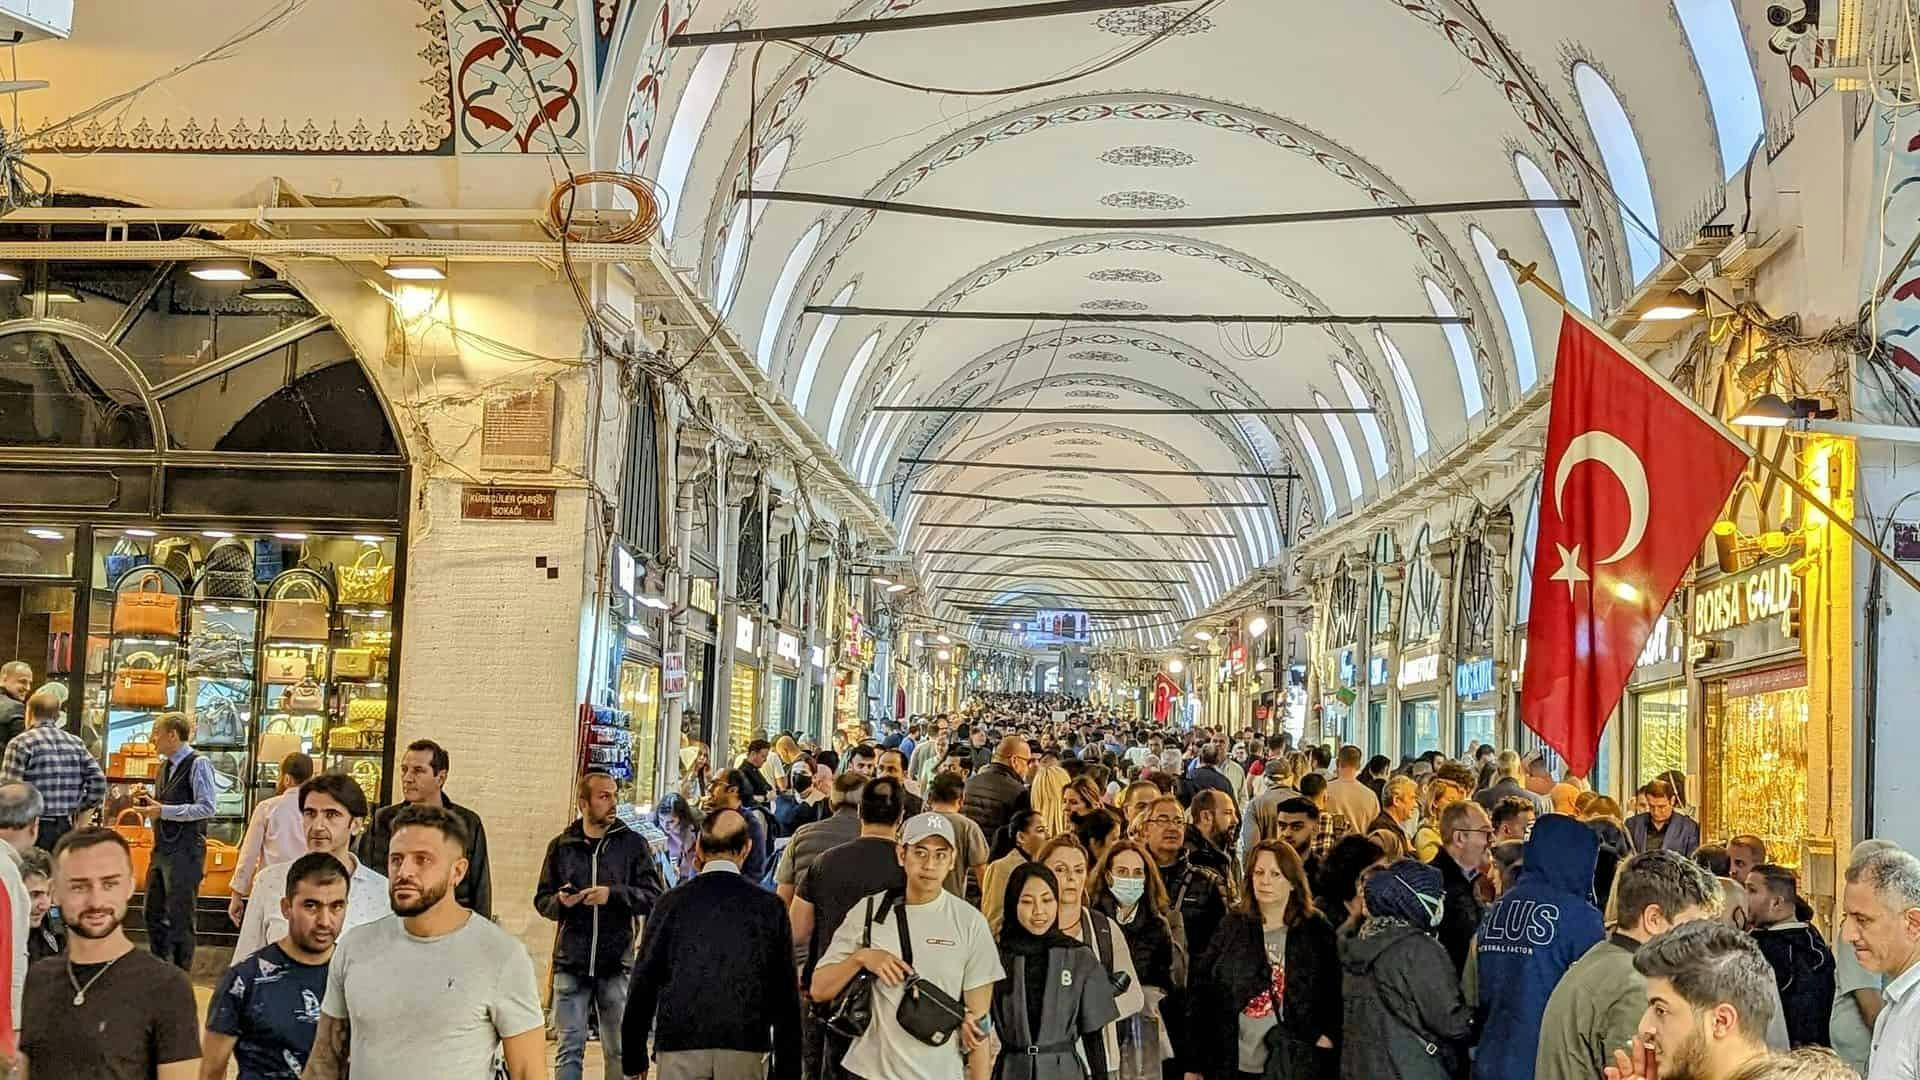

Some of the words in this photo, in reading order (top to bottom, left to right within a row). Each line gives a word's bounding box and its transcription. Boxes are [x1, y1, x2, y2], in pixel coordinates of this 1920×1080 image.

[493, 505, 522, 516] SOKAĞI
[1696, 581, 1740, 635] BORSA
[1746, 563, 1791, 621] GOLD
[1480, 900, 1559, 945] LUS
[1061, 969, 1073, 986] B
